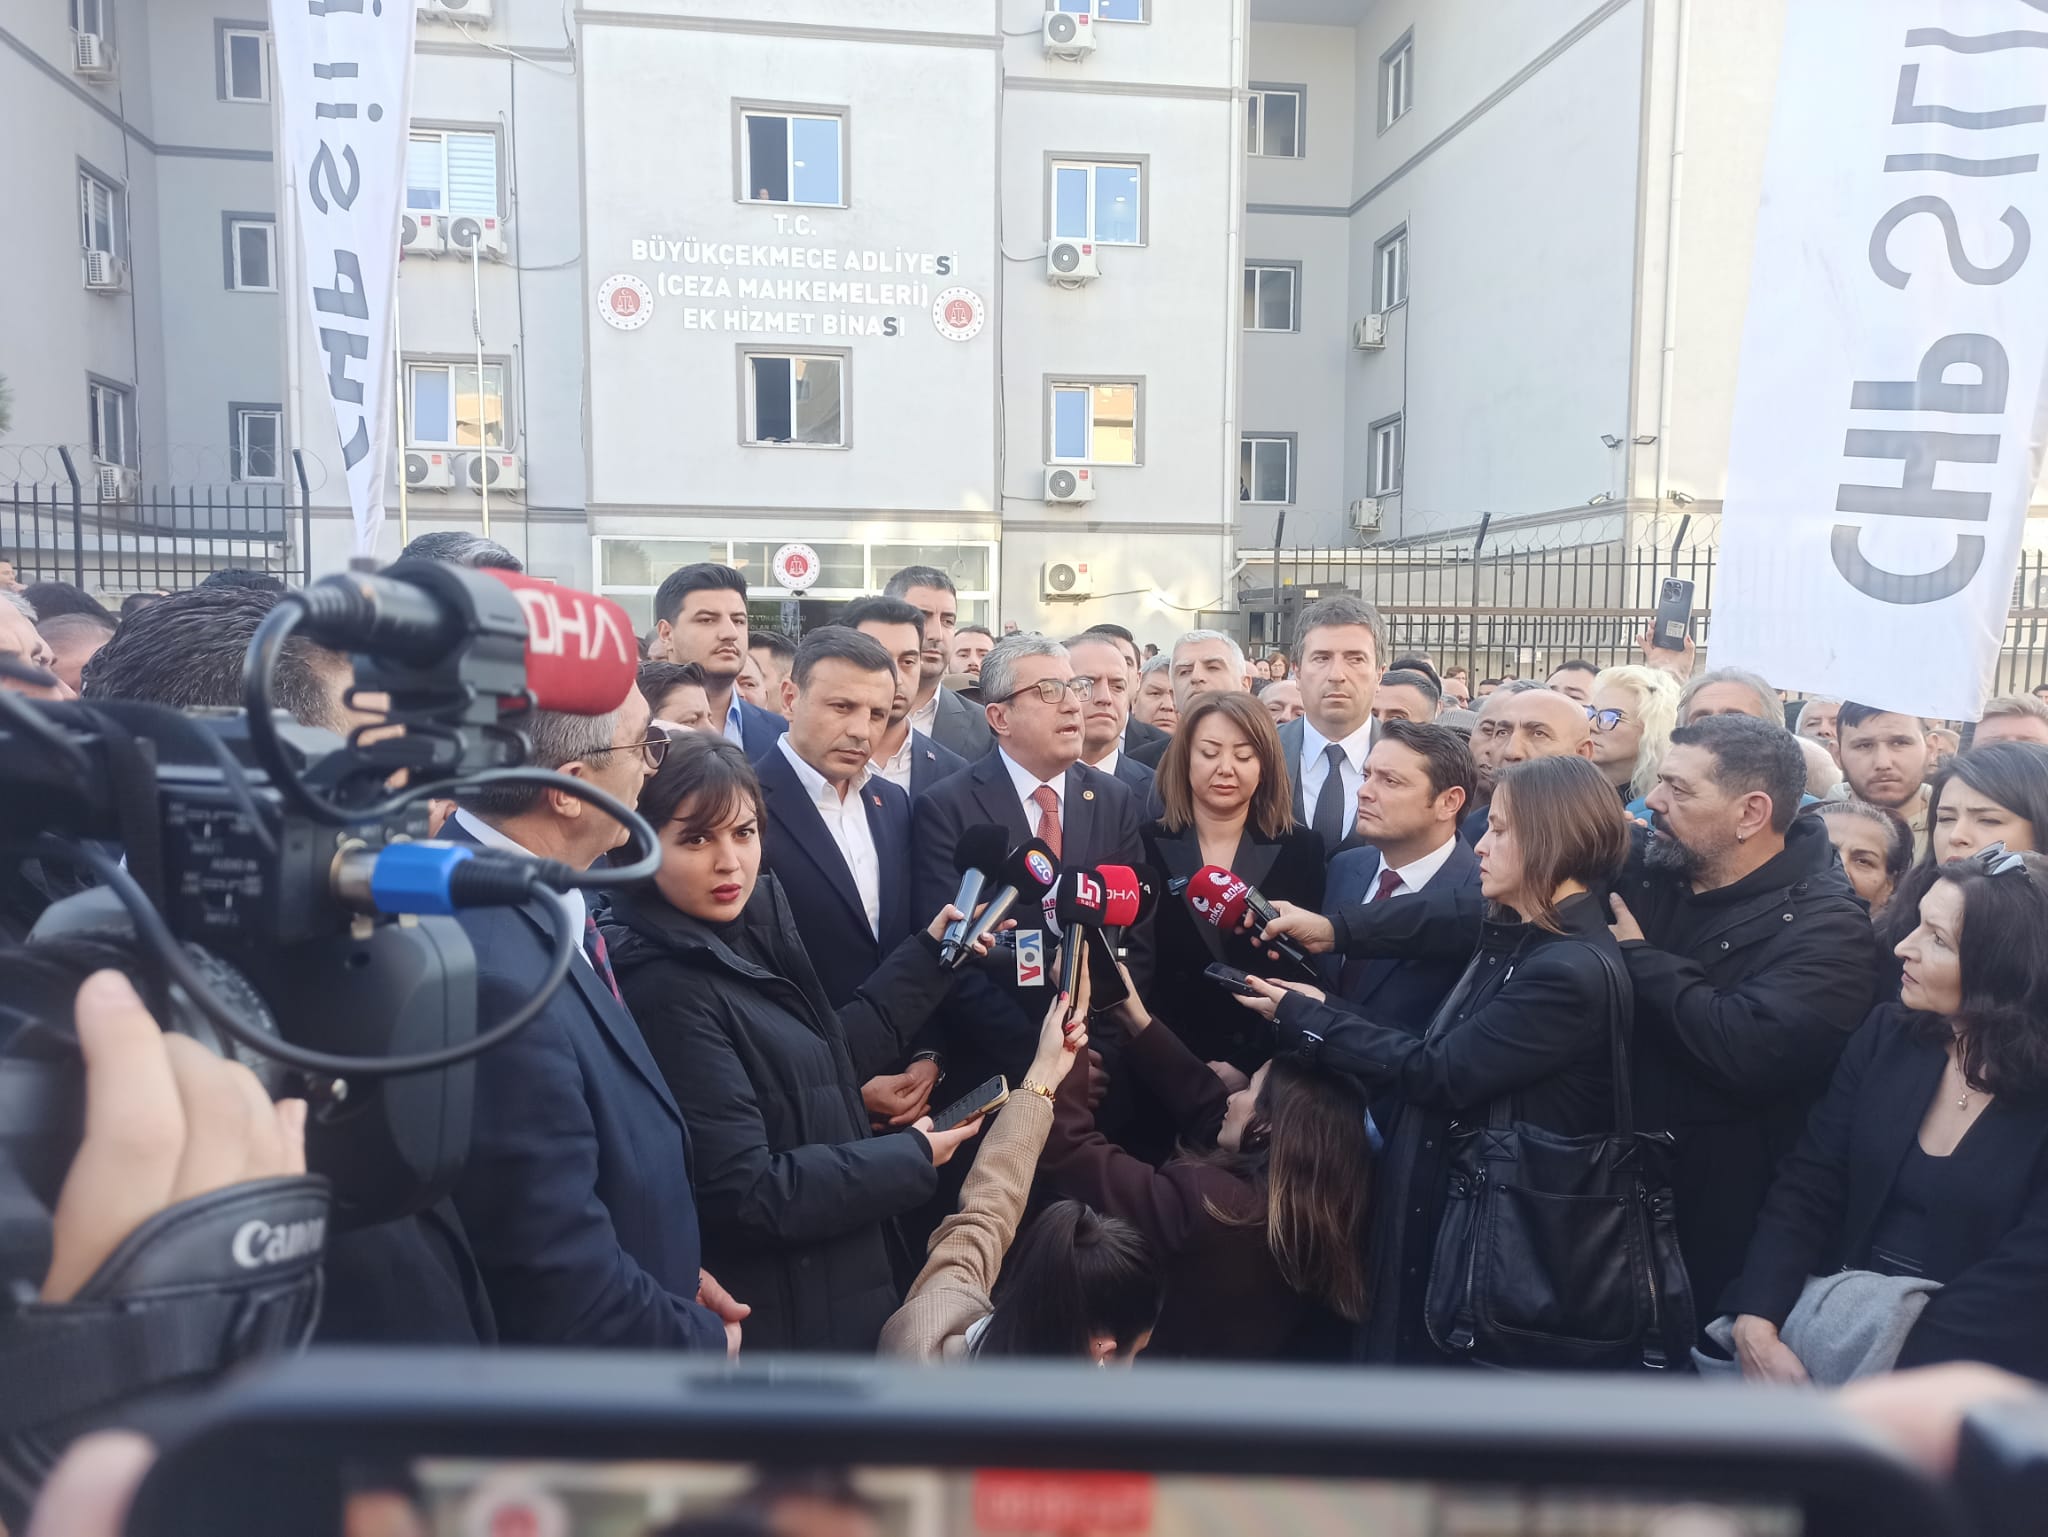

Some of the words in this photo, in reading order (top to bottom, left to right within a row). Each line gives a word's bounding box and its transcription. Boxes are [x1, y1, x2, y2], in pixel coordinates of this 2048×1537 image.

[773, 213, 817, 236] T.C.
[631, 234, 838, 270] BÜYÜKÇEKMECE
[843, 246, 959, 276] ADLİYESİ
[657, 272, 732, 298] (CEZA
[738, 277, 929, 308] MAHKEMELERİ)
[683, 307, 718, 331] EK
[723, 305, 816, 334] HİZMET
[822, 309, 906, 337] BİNASI
[512, 588, 628, 664] DHA
[1030, 855, 1051, 881] SZC
[1106, 888, 1137, 901] DHA
[1221, 881, 1246, 901] anka
[1208, 902, 1224, 925] anka
[1018, 932, 1041, 983] VOA
